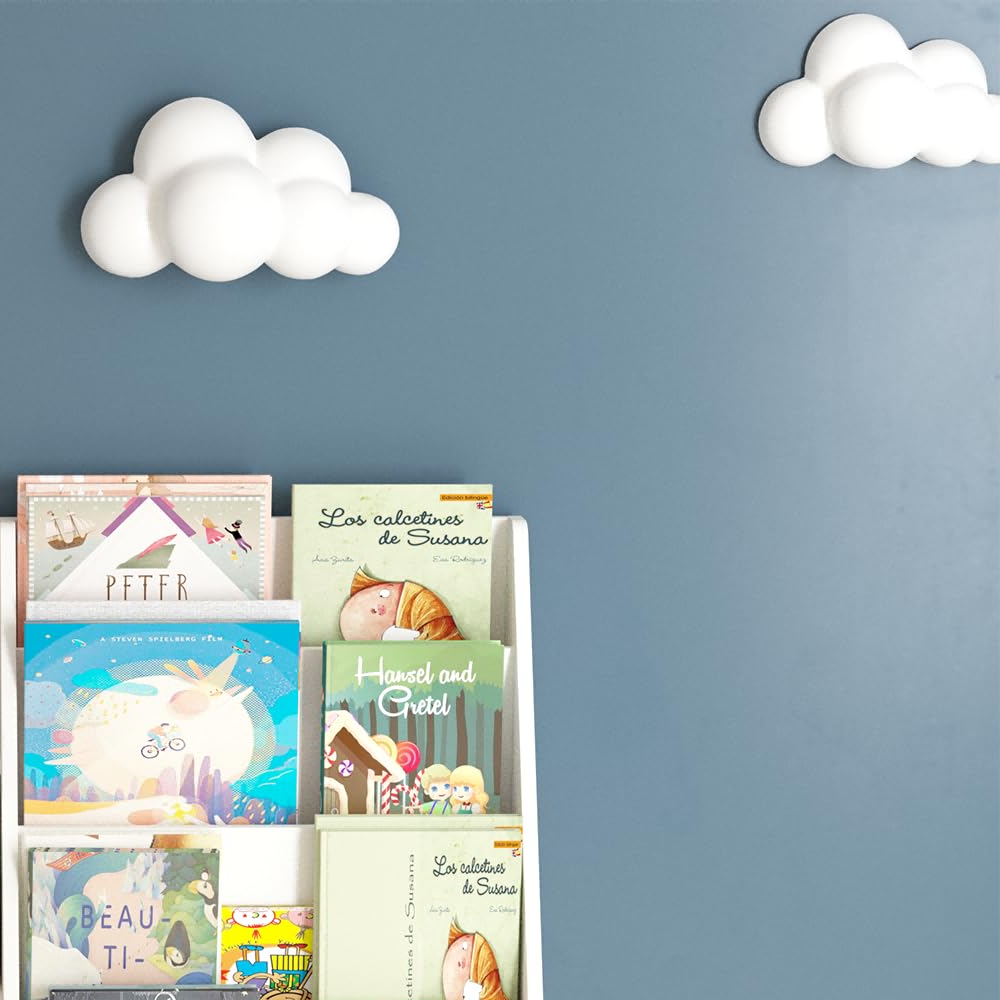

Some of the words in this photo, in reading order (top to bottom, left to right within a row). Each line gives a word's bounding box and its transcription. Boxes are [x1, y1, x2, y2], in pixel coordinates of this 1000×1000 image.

[318, 508, 366, 528] Los
[374, 510, 464, 526] calcetines
[379, 530, 400, 545] de
[407, 528, 488, 546] Susana
[354, 656, 434, 686] Hansel
[439, 661, 476, 684] and
[378, 685, 451, 719] Gretel
[433, 855, 458, 877] Los
[460, 857, 506, 874] calcetines
[405, 854, 416, 919] Susana
[462, 879, 474, 895] de
[476, 877, 518, 896] Susana
[81, 904, 171, 929] BEAU-
[405, 924, 413, 945] de
[104, 945, 145, 970] TI-
